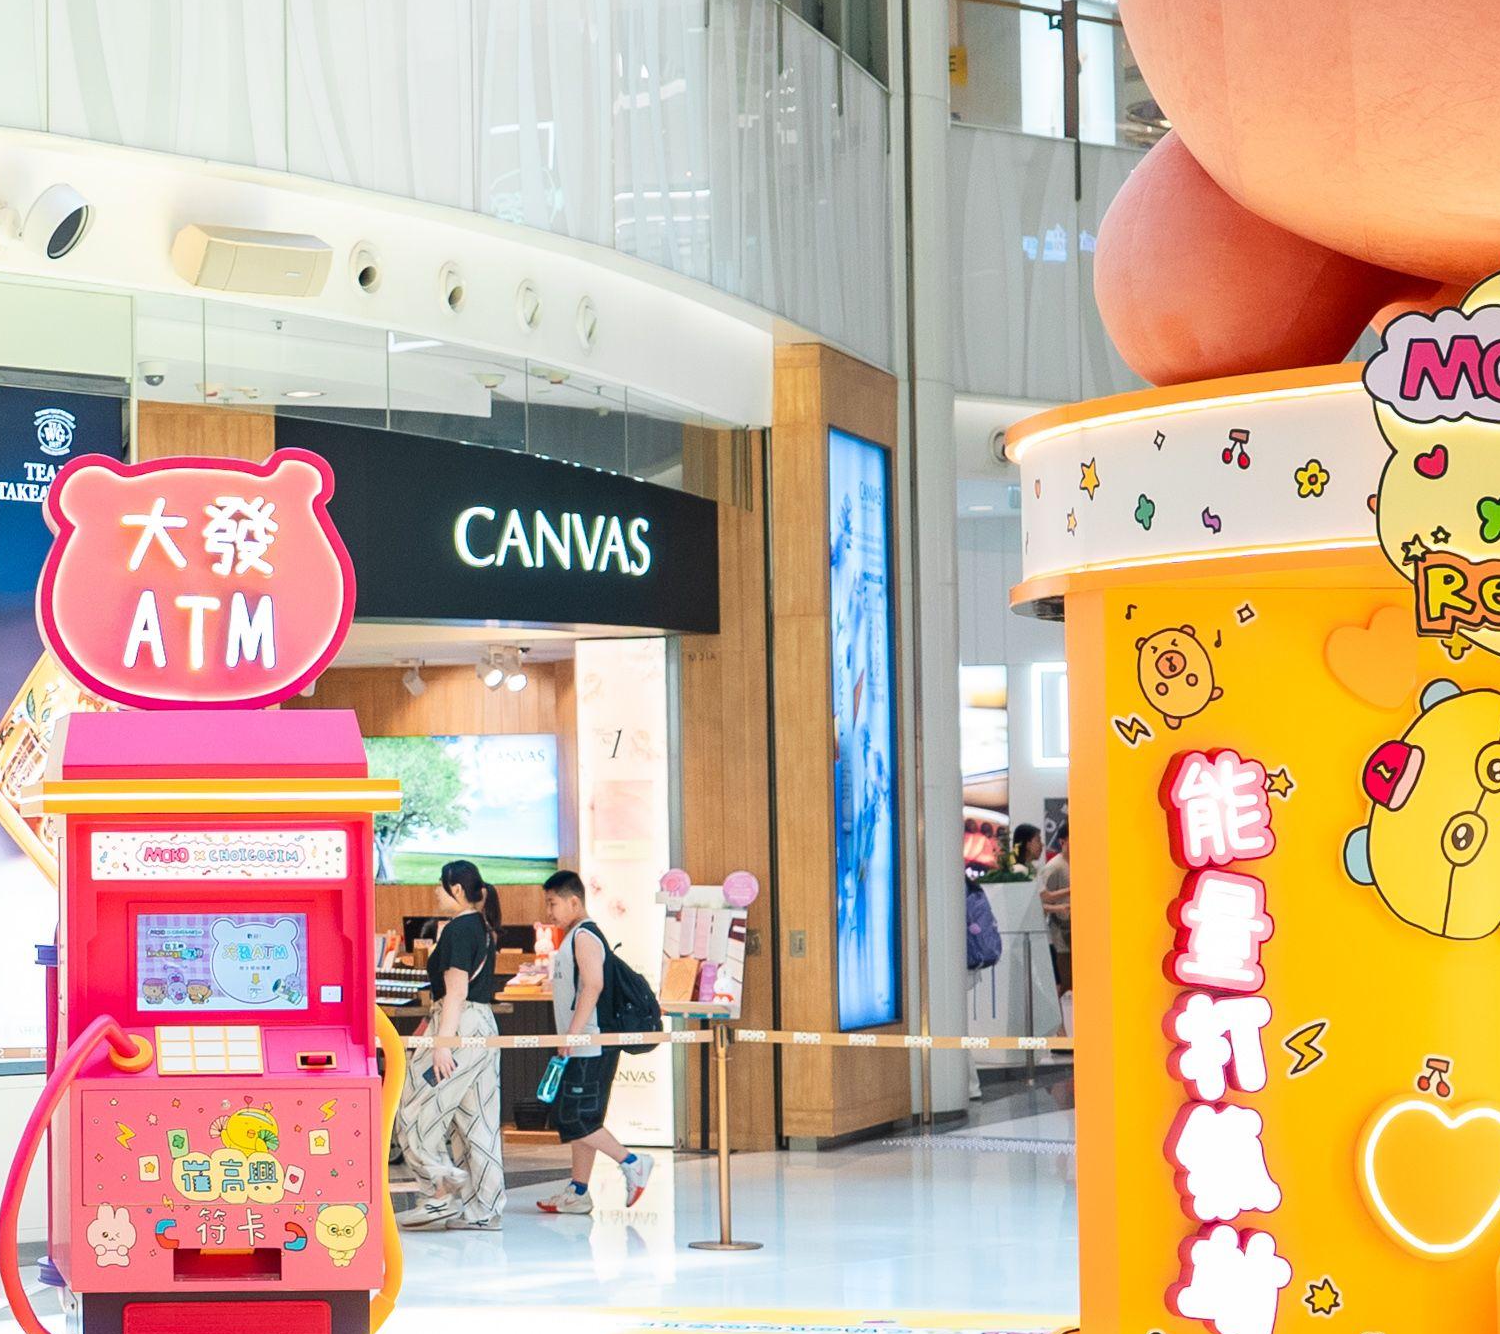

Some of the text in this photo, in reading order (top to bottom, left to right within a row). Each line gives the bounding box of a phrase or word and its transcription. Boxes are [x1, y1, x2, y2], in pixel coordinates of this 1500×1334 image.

[120, 496, 279, 577] 大發
[454, 504, 652, 576] CANVAS
[123, 589, 278, 672] ATM
[144, 847, 189, 864] MOKO
[208, 848, 300, 863] CHOIGOSIM
[196, 1207, 266, 1247] 符卡
